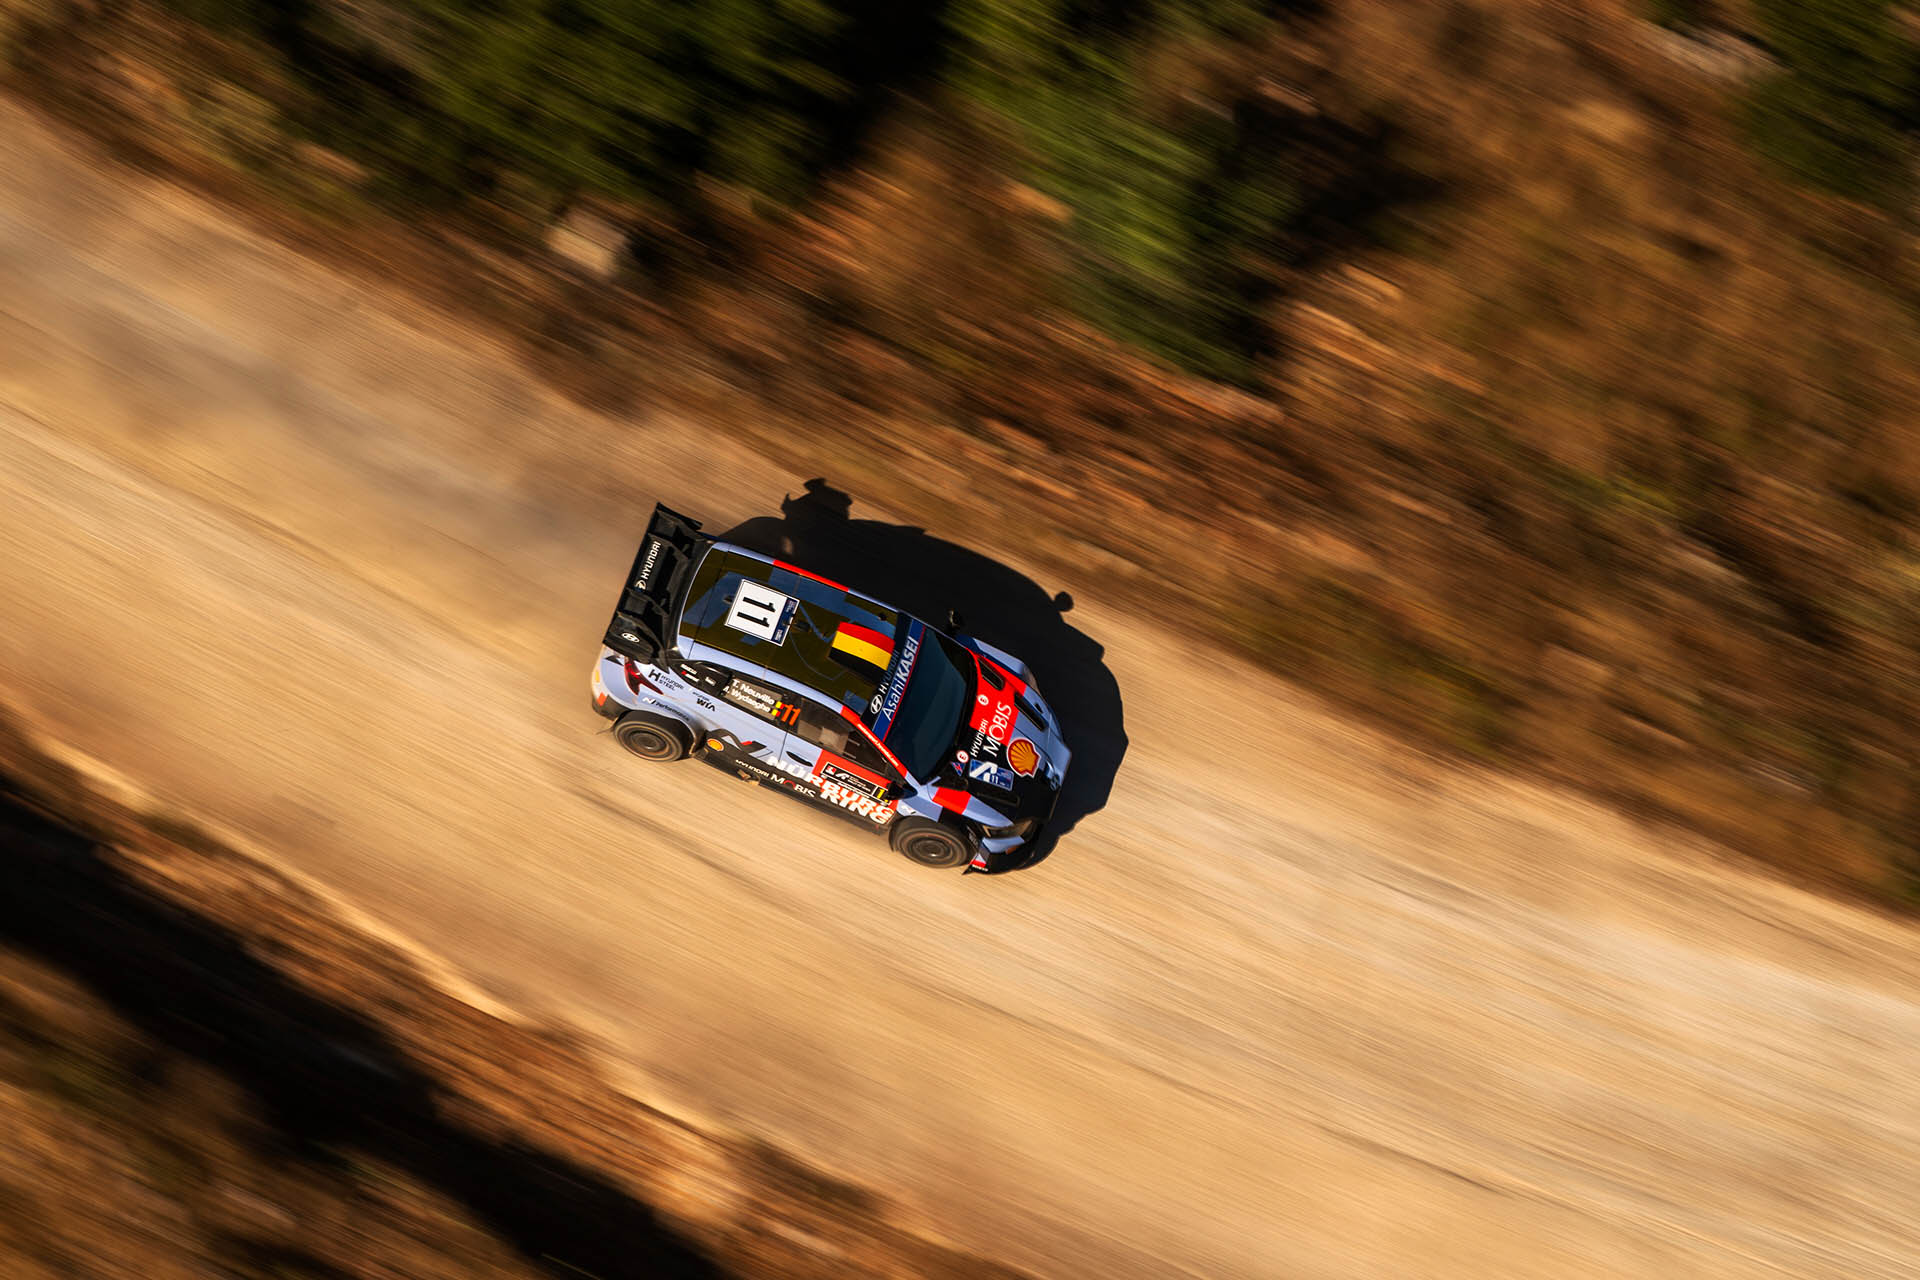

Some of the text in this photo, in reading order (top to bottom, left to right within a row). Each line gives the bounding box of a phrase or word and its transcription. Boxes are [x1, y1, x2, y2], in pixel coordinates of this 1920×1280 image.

[641, 541, 661, 580] HYUNDAI
[737, 596, 776, 628] 11
[659, 680, 676, 691] STEEL
[879, 650, 900, 694] HYUNDAI
[781, 704, 801, 726] 11
[983, 701, 1012, 757] MOBIS
[969, 719, 989, 757] HYUNDAI
[770, 773, 816, 798] MOBIS
